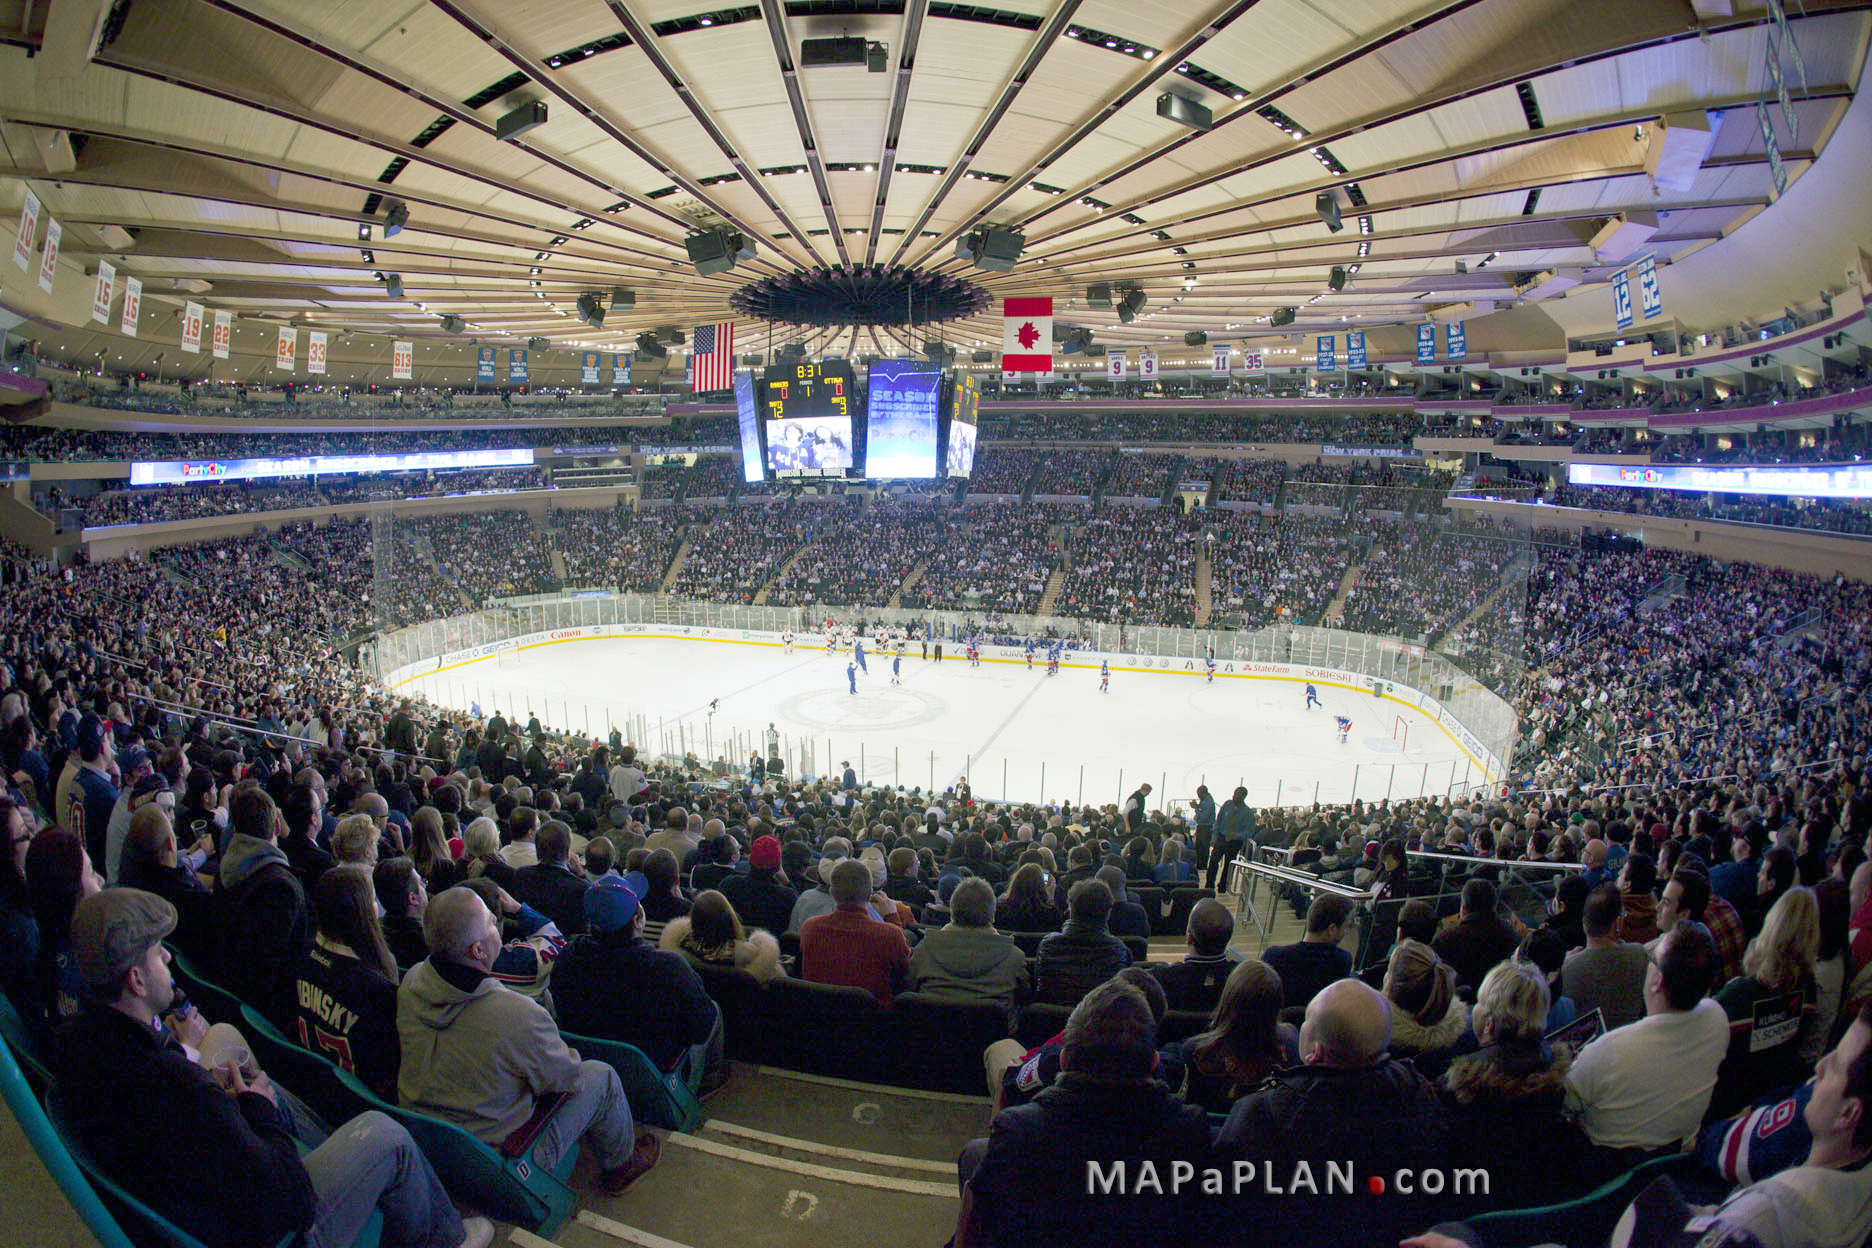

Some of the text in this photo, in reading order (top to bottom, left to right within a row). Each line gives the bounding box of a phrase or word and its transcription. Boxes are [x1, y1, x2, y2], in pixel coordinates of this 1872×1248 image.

[20, 211, 34, 249] 10
[44, 239, 57, 272] 12
[97, 279, 111, 306] 15
[1640, 269, 1660, 310] 62
[125, 294, 138, 319] 15
[1614, 283, 1632, 321] 12
[186, 316, 201, 338] 19
[215, 324, 229, 344] 22
[280, 339, 295, 357] 24
[311, 343, 326, 362] 33
[394, 353, 411, 368] 613
[1113, 361, 1121, 375] 9
[1145, 360, 1153, 374] 9
[1215, 356, 1227, 371] 11
[1246, 354, 1262, 369] 35
[797, 364, 821, 378] 8:31
[781, 387, 788, 399] 0
[806, 386, 810, 397] 1
[835, 383, 843, 396] 0
[872, 389, 937, 403] SEASON
[773, 407, 783, 418] 12
[840, 402, 847, 415] 3
[871, 402, 937, 412] SUBSCRIBER
[257, 459, 310, 473] SEASON
[1691, 471, 1744, 487] SEASON
[521, 634, 546, 645] DELTA
[550, 629, 581, 639] Canon
[446, 652, 472, 664] CHASE
[1305, 668, 1351, 683] SOBIESKI
[781, 1190, 819, 1221] D
